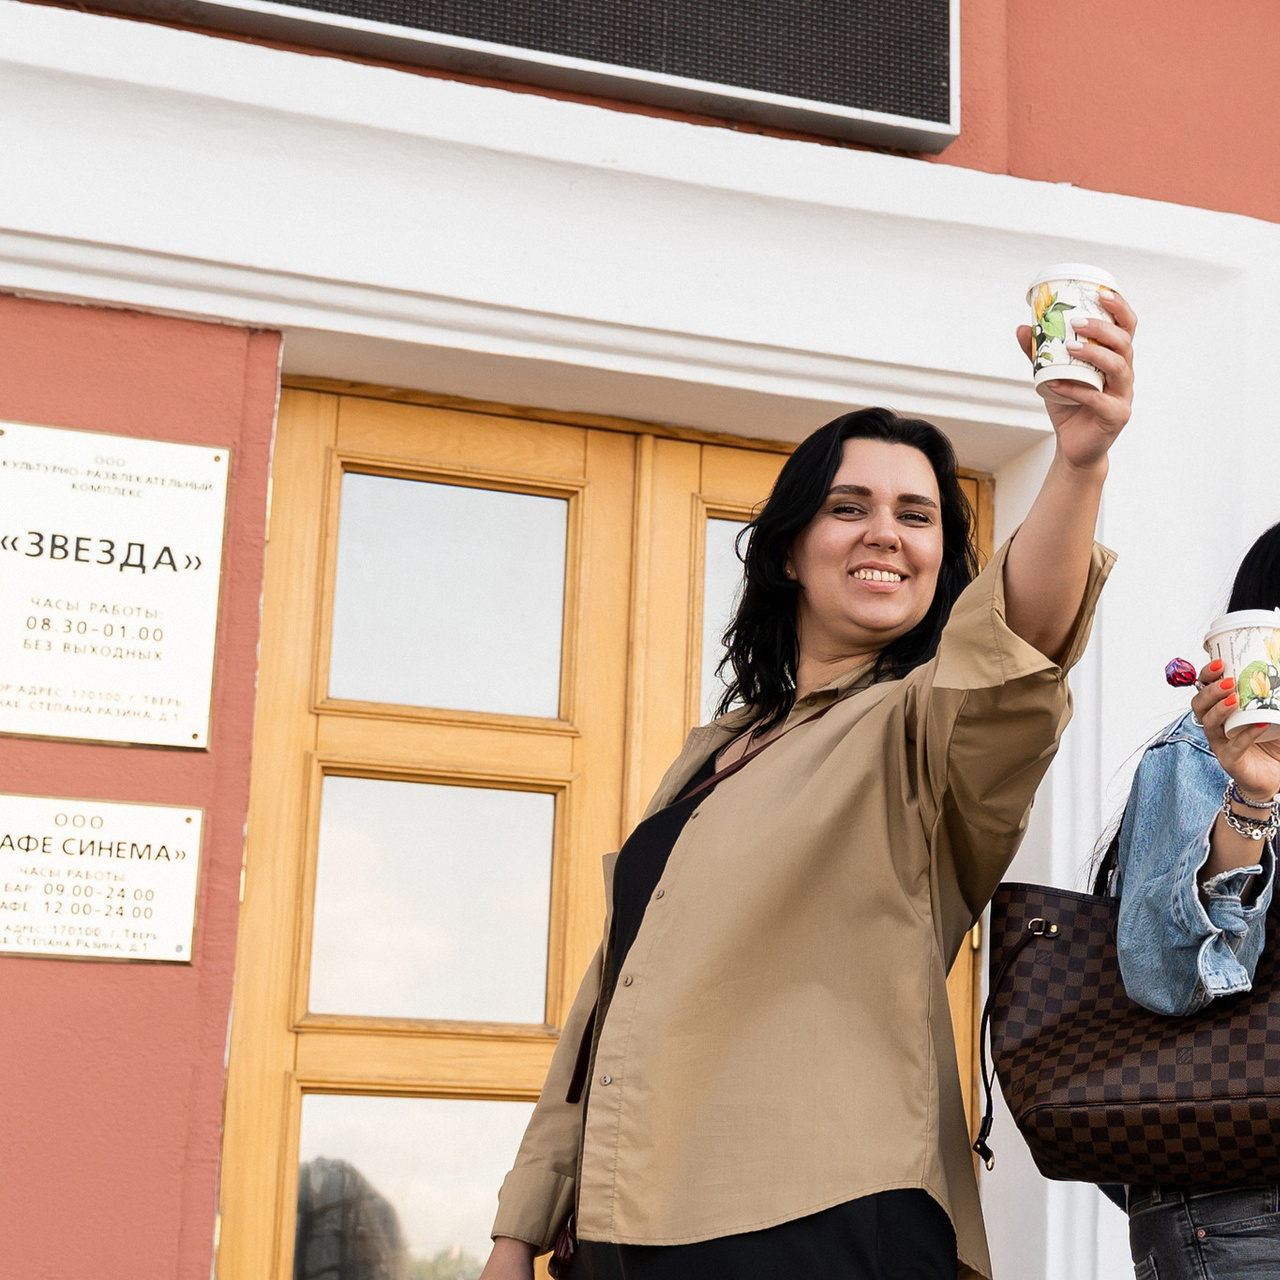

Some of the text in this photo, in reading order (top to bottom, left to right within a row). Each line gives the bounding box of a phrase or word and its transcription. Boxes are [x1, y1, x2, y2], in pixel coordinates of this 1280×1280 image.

[1, 531, 202, 574] «ЗВЕЗДА»
[31, 597, 80, 611] ЧАСЫ
[26, 616, 164, 642] 08.30-01.00
[23, 639, 163, 661] БЕЗ ВЫХОДНЫХ
[54, 813, 104, 829] ООО
[62, 837, 187, 862] СИНЕМА»
[19, 867, 61, 878] ЧАСЫ
